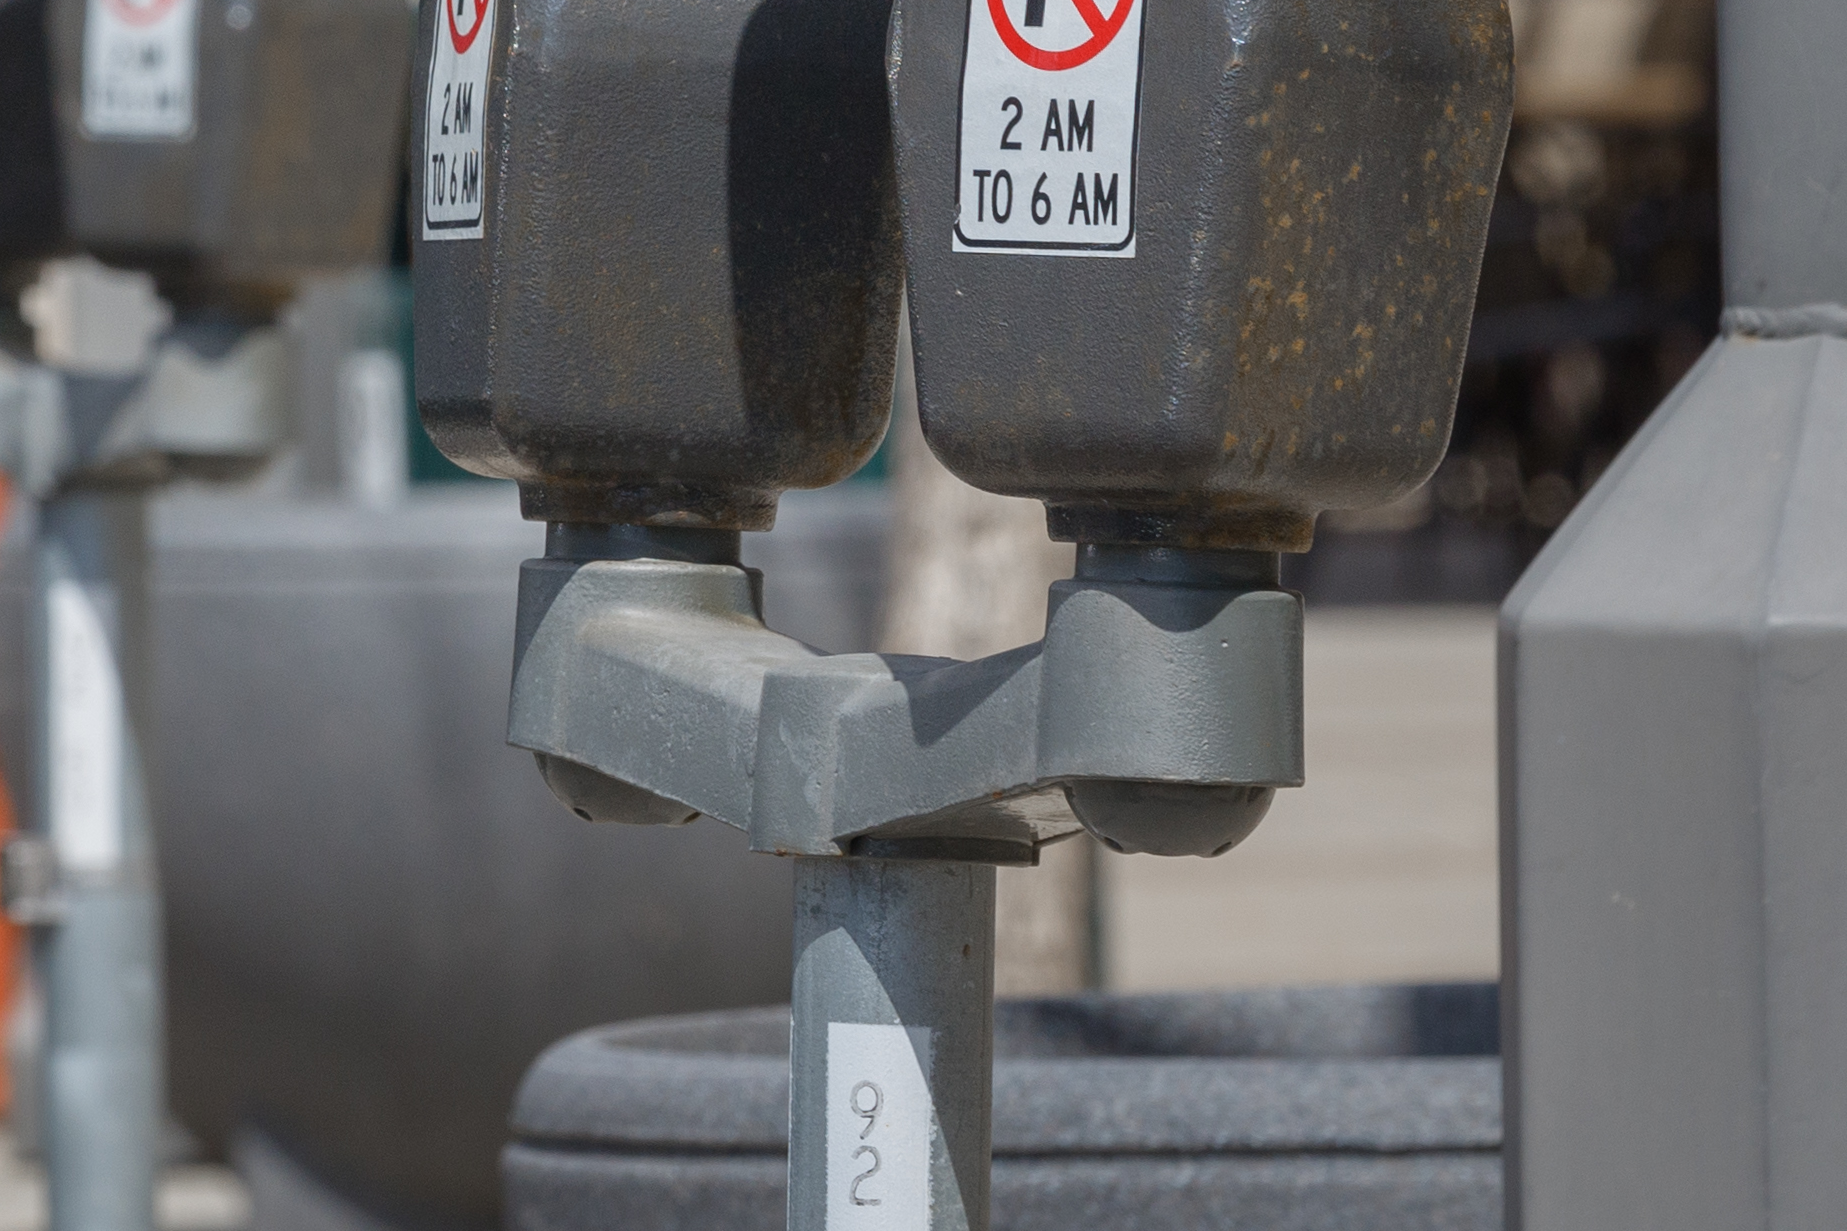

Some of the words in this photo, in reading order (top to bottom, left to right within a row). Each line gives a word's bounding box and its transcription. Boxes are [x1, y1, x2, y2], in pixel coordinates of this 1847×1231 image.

[441, 82, 451, 135] 2
[454, 82, 473, 134] AM
[999, 96, 1023, 150] 2
[1040, 98, 1095, 152] AM
[432, 152, 446, 206] TO
[449, 152, 457, 205] 6
[461, 151, 479, 204] AM
[973, 169, 1013, 224] TO
[1031, 172, 1051, 226] 6
[1068, 172, 1119, 226] AM
